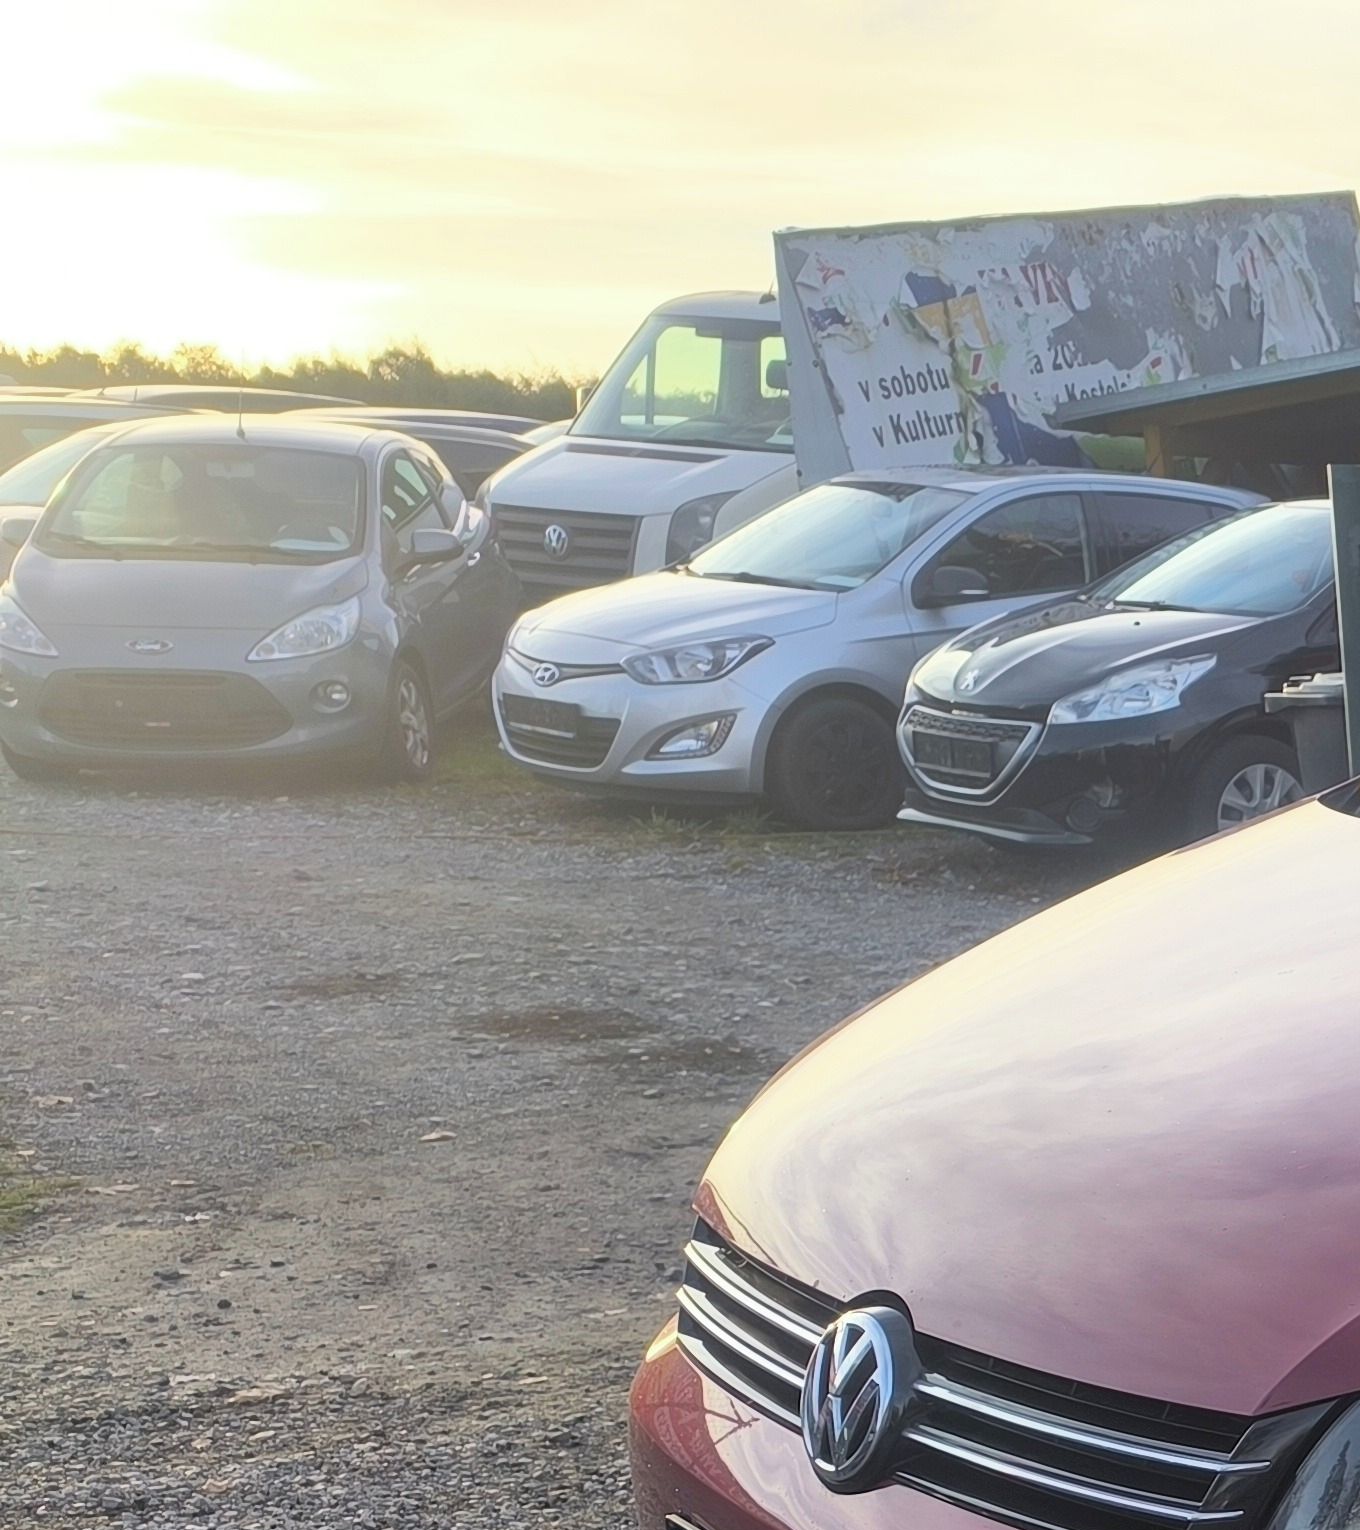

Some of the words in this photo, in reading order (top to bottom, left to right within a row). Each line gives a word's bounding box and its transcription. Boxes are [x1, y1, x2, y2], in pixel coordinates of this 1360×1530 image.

[857, 379, 871, 402] v
[877, 362, 950, 400] sobotu
[872, 425, 886, 448] v
